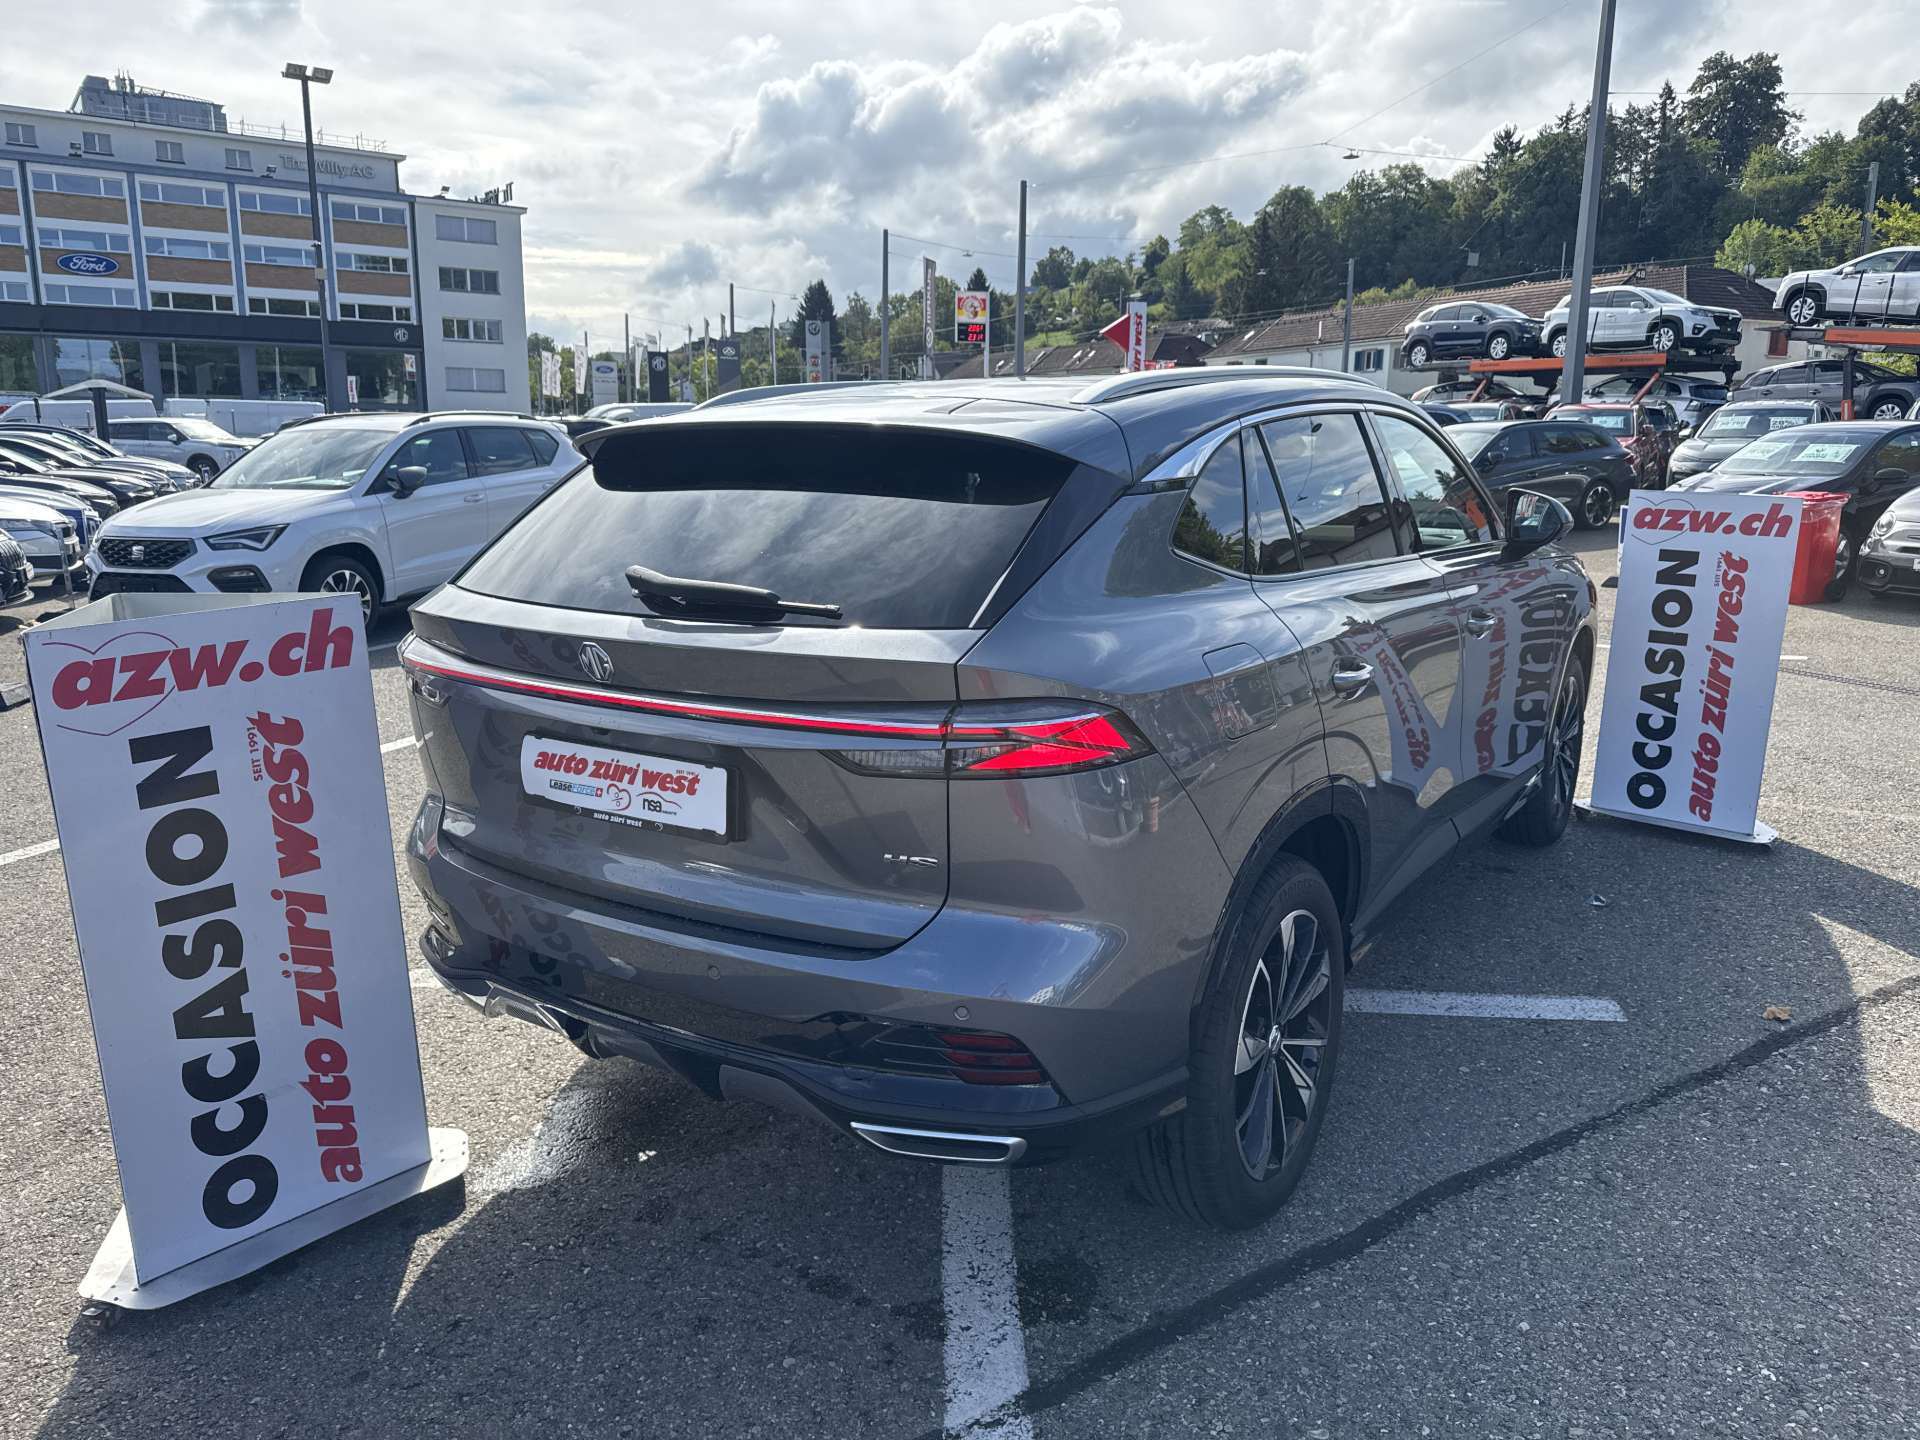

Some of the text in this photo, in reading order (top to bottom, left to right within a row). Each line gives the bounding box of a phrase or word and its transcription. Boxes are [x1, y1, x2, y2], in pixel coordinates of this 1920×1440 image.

[351, 165, 376, 179] AG
[70, 255, 107, 272] Ford
[394, 328, 409, 342] MG
[1633, 503, 1793, 538] azw.ch
[52, 608, 354, 710] azw.ch
[579, 642, 614, 682] MG
[1626, 548, 1700, 810] OCCASION
[1688, 550, 1750, 823] auto züri west
[246, 726, 264, 782] SEIT 1991
[534, 750, 701, 796] auto züri west
[593, 813, 642, 828] auto züri west
[643, 798, 662, 812] nsa
[246, 709, 361, 1184] auto züri west
[129, 726, 279, 1230] OCCASION
